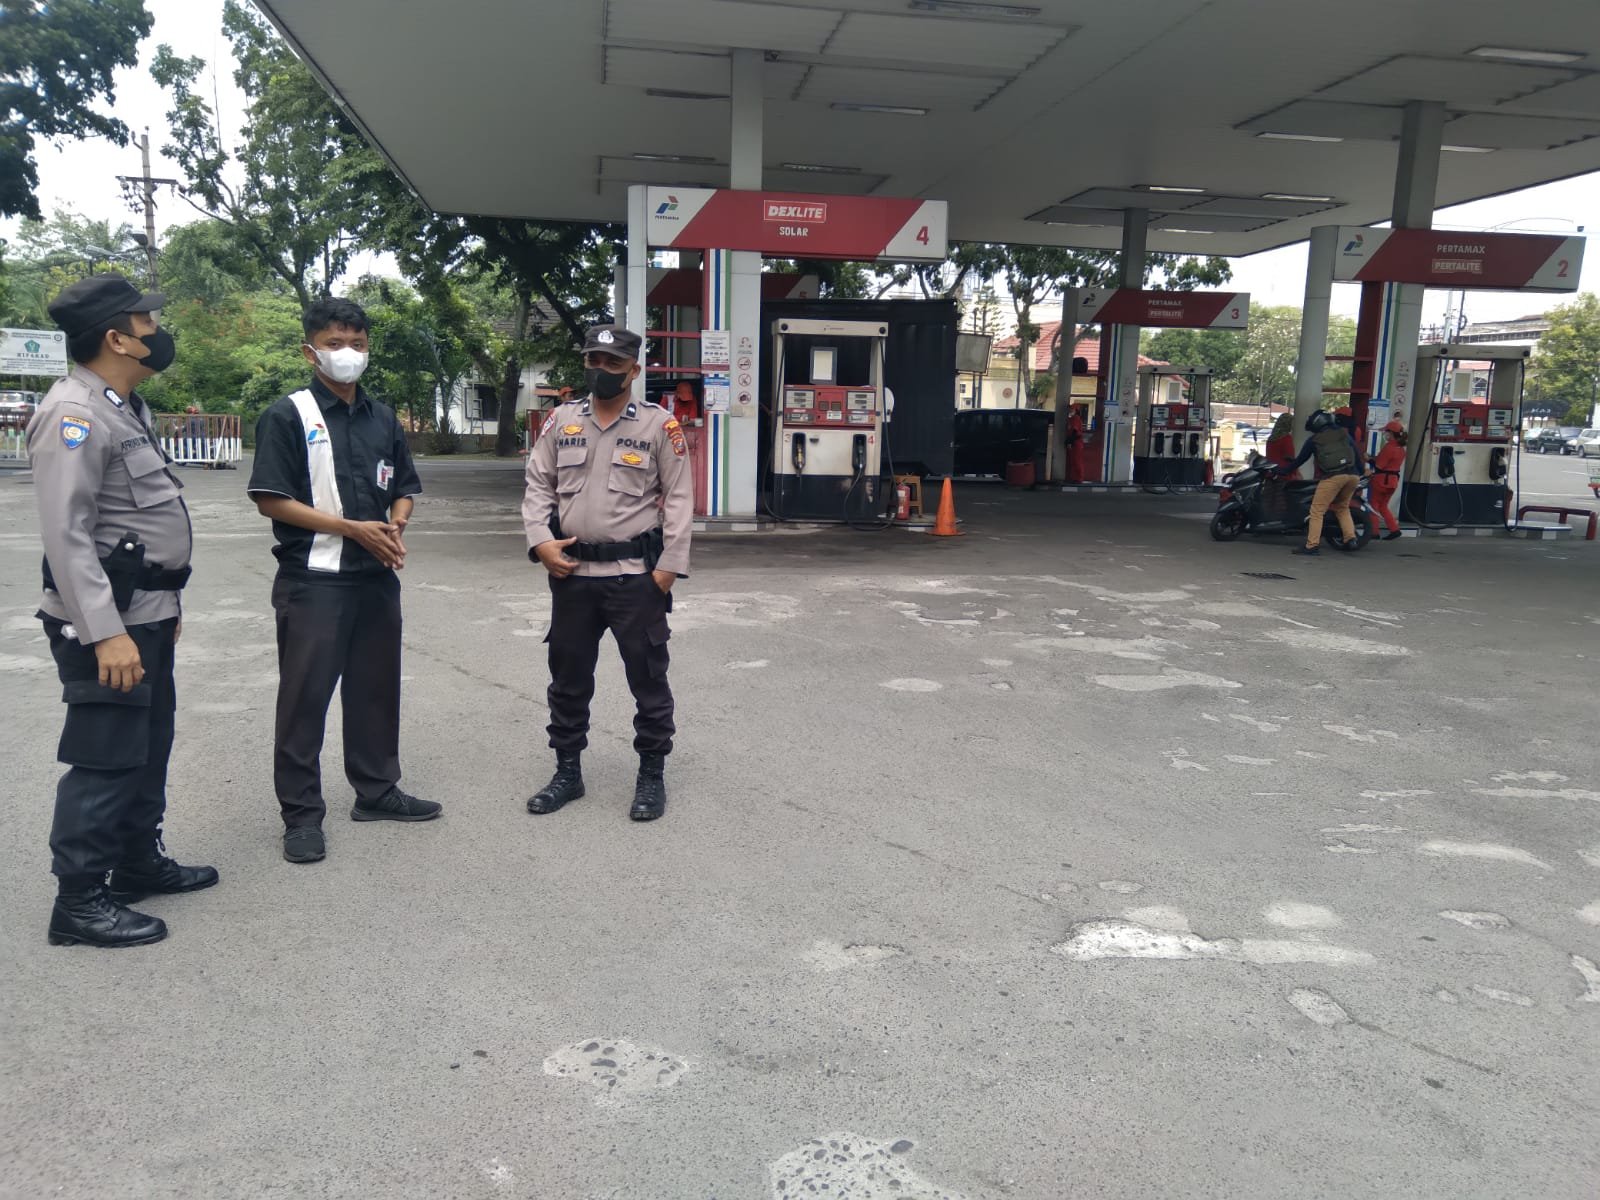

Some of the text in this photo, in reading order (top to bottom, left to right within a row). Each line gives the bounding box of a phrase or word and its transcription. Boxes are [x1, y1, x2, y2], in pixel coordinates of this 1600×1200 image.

[768, 205, 823, 218] DEXLITE
[779, 226, 808, 237] SOLAR
[916, 225, 929, 246] 4
[1436, 244, 1486, 254] PERTAMAX
[1434, 261, 1481, 271] PERTALITE
[1557, 259, 1569, 278] 2
[1231, 308, 1240, 320] 3
[616, 438, 652, 450] POLRI
